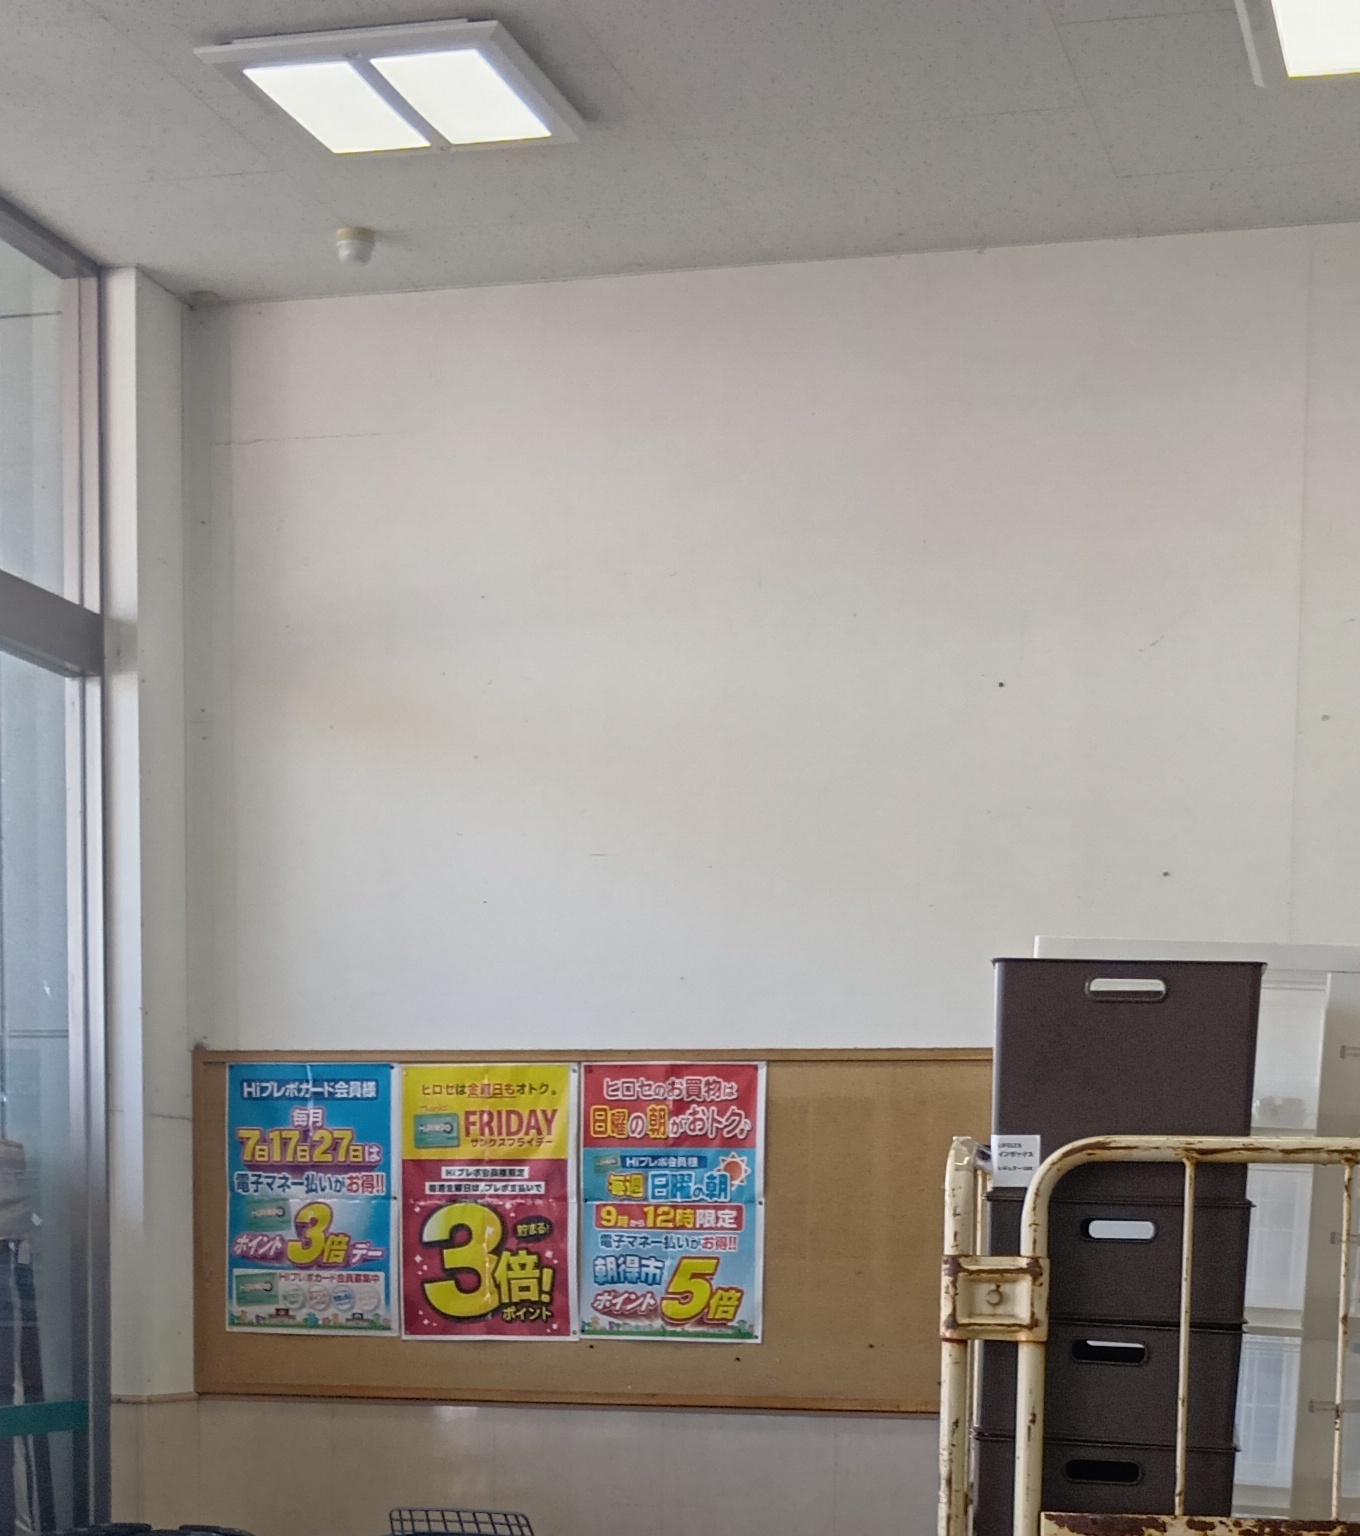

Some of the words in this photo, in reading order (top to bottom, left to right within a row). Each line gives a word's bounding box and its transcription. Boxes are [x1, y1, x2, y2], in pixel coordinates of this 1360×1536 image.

[604, 1077, 738, 1100] ヒロセのお買物は
[293, 1108, 323, 1126] 毎月
[464, 1109, 558, 1137] FRIDAY
[594, 1255, 665, 1286] 朝得市
[502, 1305, 552, 1321] ポイント
